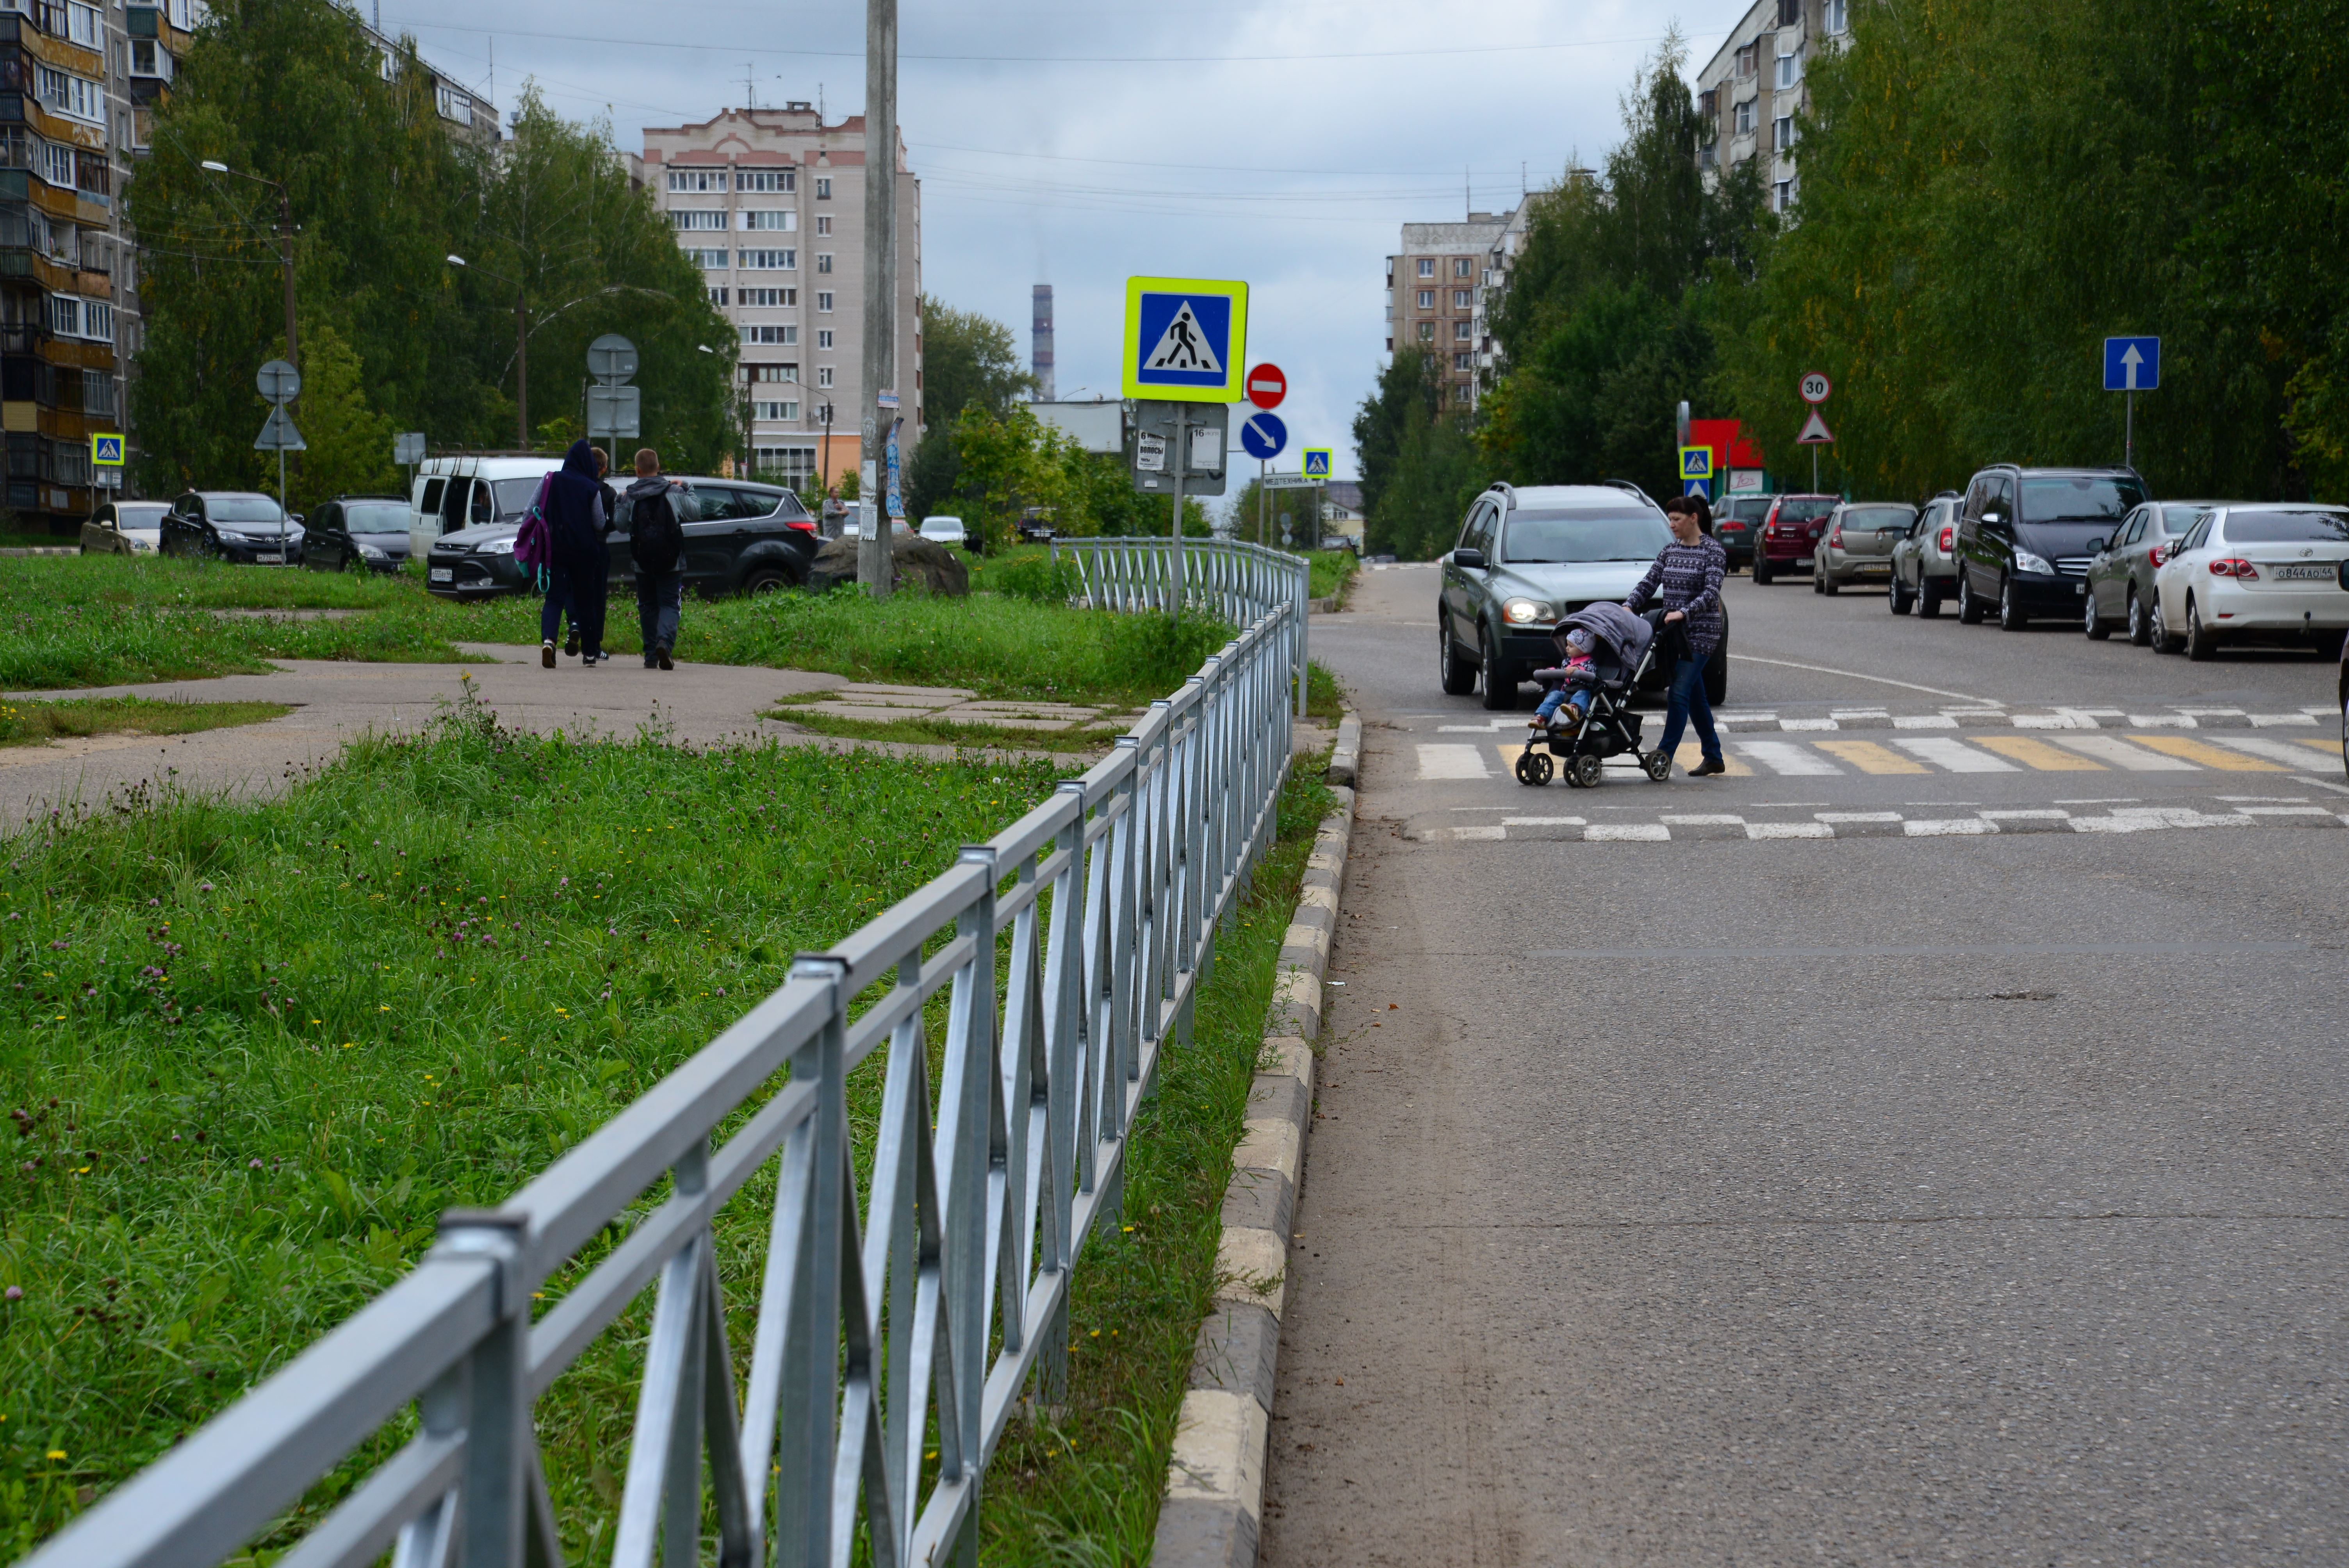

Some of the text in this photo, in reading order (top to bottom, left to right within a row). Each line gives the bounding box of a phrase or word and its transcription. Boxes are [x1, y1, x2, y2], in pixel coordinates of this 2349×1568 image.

[1805, 382, 1823, 394] 30
[1140, 446, 1164, 454] ВОЛОСЫ
[2279, 568, 2319, 578] О844АО
